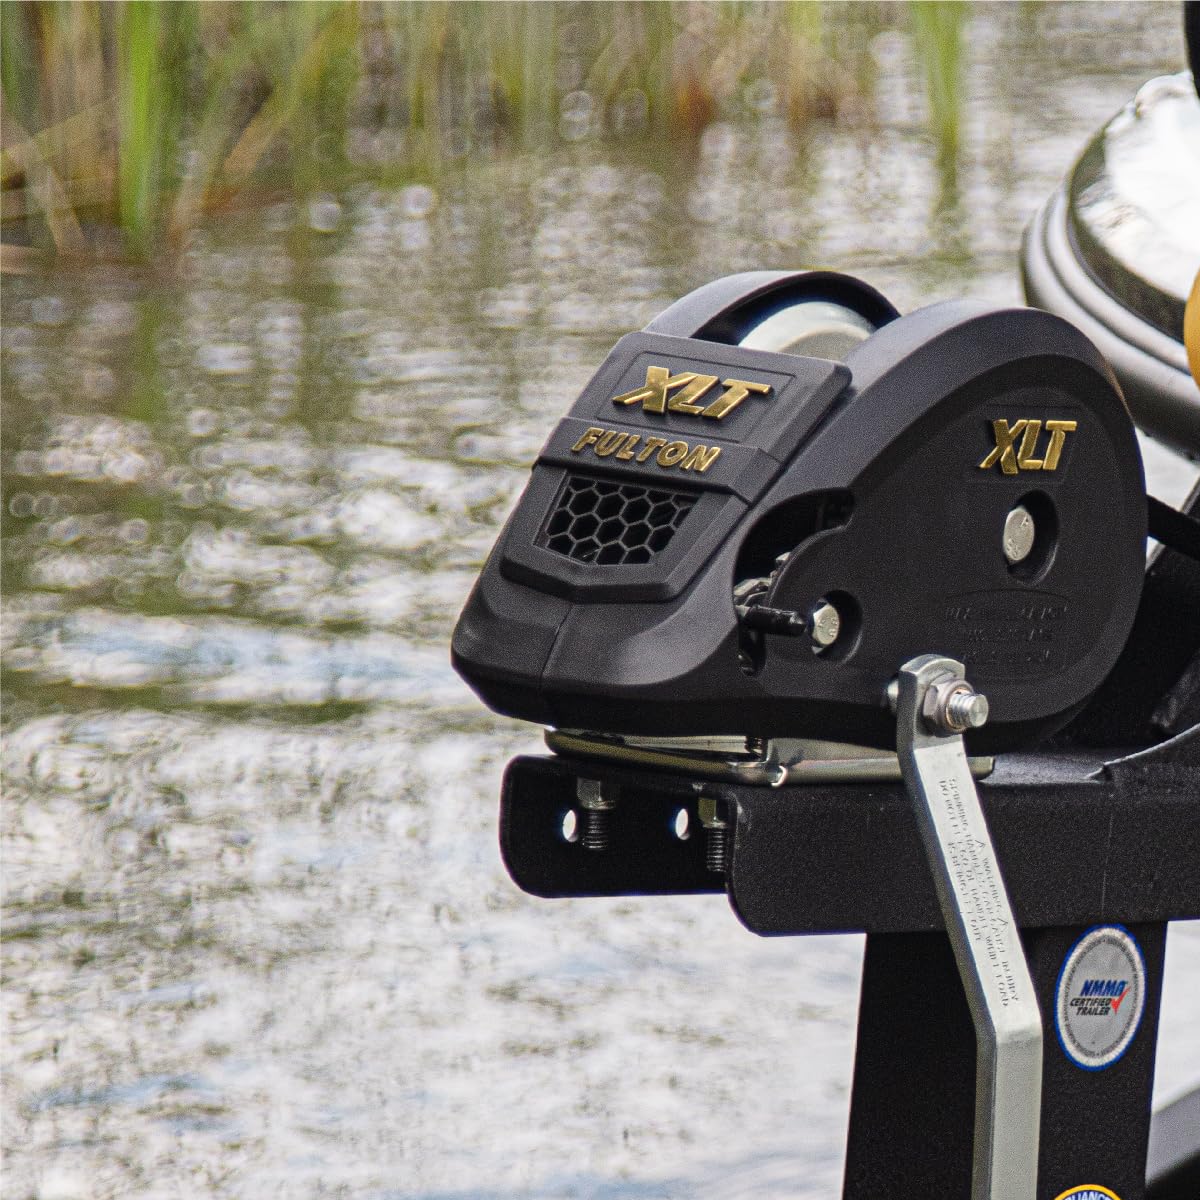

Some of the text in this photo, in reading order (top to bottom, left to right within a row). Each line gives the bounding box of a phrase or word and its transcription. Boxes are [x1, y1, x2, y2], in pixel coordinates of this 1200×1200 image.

[612, 365, 772, 420] XLT
[571, 427, 722, 473] FULTON
[979, 418, 1078, 475] XLT
[1070, 998, 1112, 1007] CERTIFIED
[1080, 979, 1127, 997] NMMA
[1076, 1006, 1111, 1016] TRAILER
